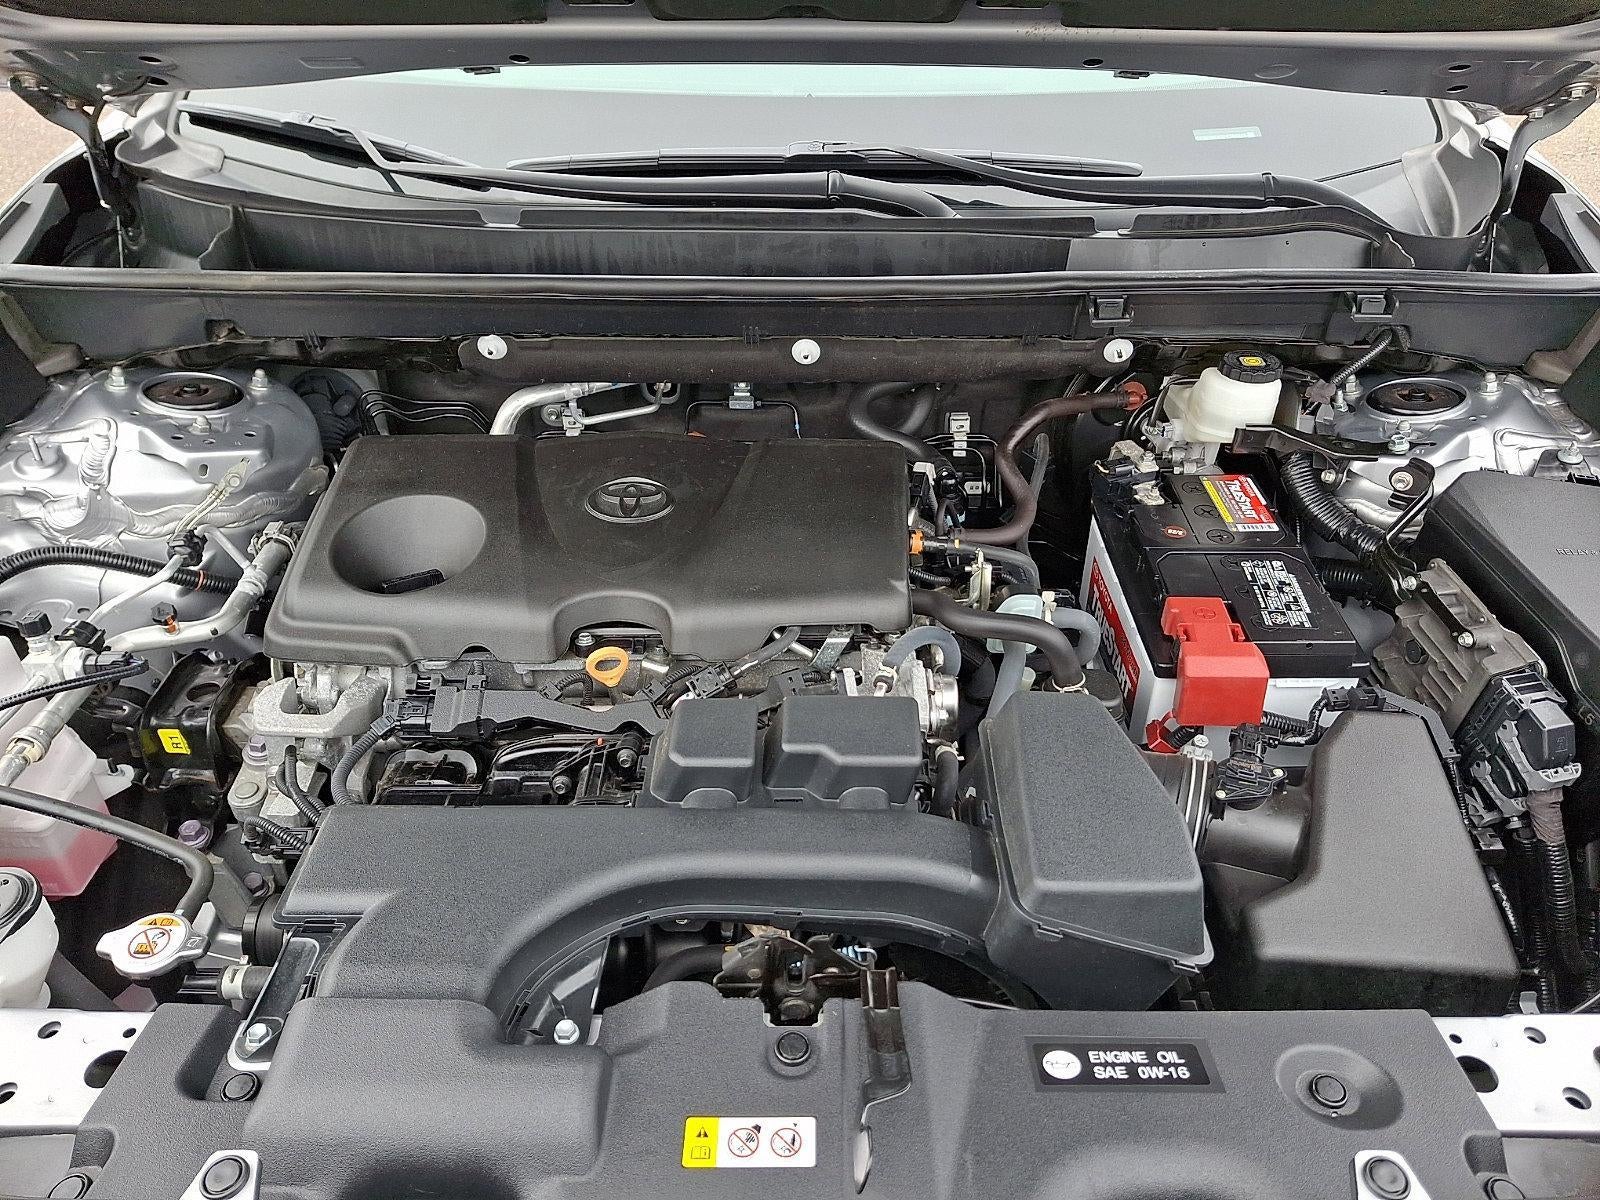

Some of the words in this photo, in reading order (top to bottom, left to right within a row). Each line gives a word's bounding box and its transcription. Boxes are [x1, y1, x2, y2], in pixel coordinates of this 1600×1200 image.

[1087, 1050, 1149, 1064] ENGINE
[1156, 1050, 1186, 1064] OIL
[1093, 1066, 1130, 1080] SAE
[1137, 1066, 1191, 1080] 0W-16
